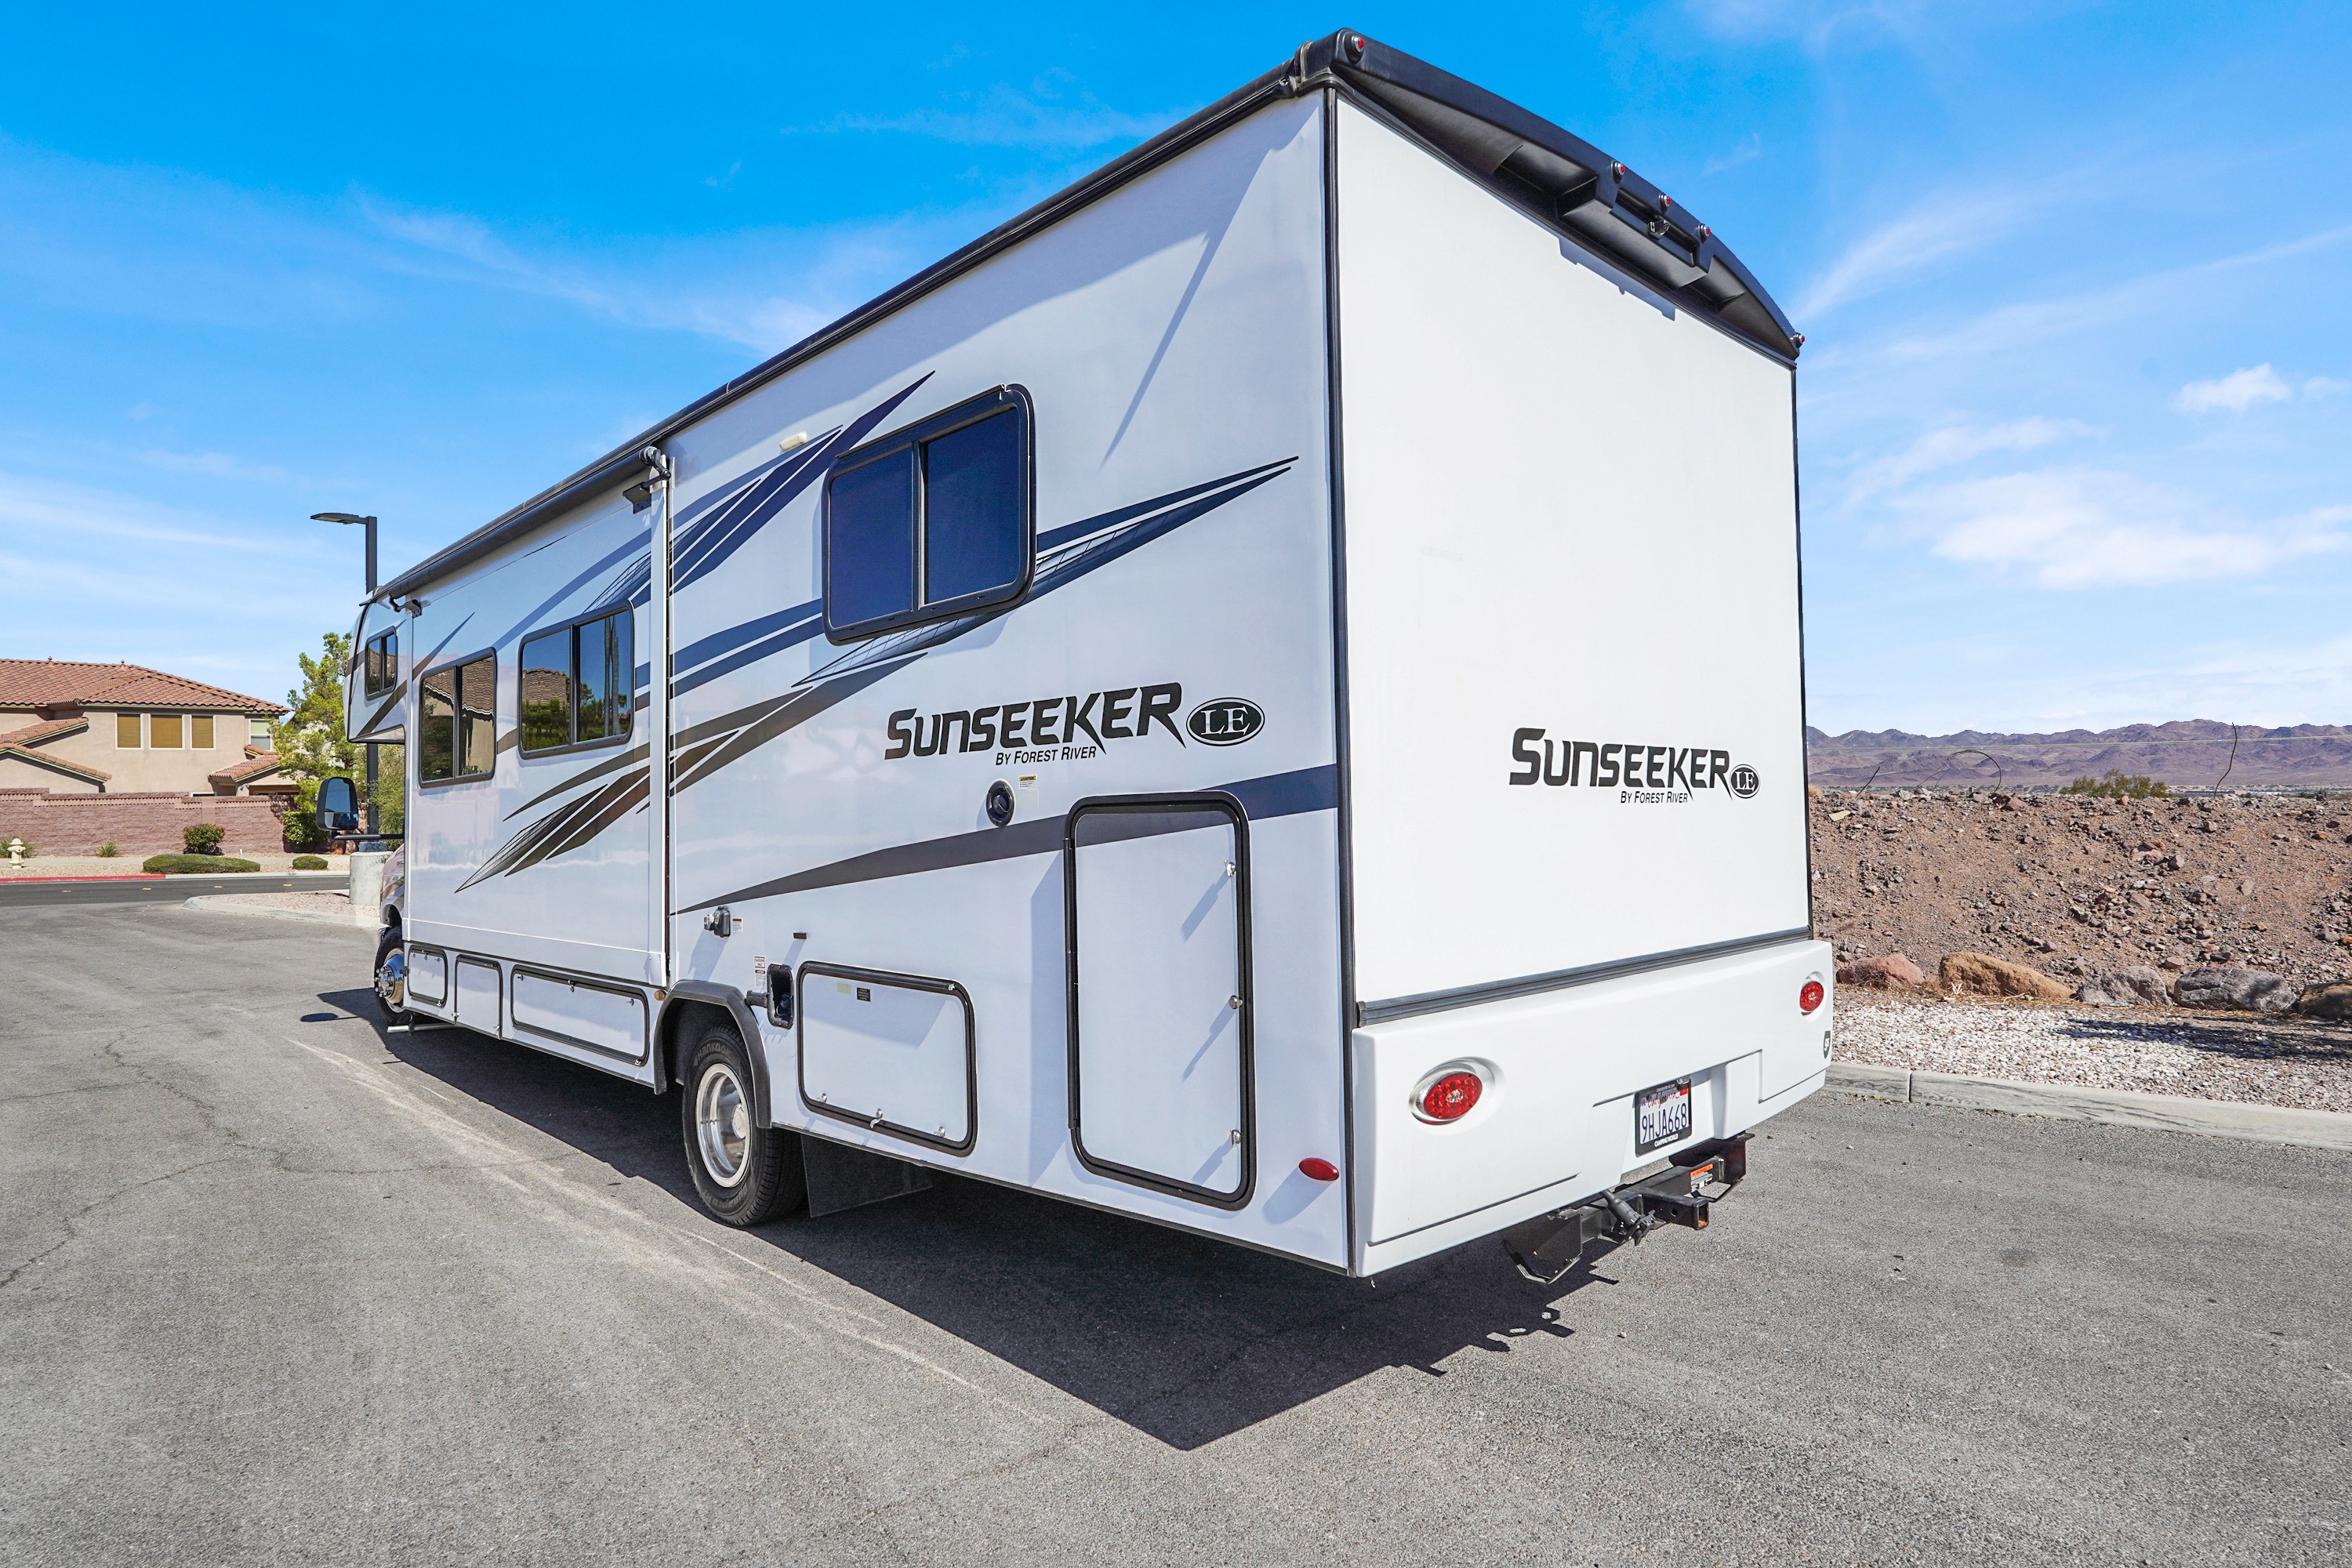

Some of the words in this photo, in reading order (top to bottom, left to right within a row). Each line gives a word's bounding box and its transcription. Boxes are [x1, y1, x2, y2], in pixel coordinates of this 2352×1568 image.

[1200, 706, 1250, 735] LE
[1734, 771, 1755, 792] LE
[1642, 1103, 1686, 1142] 9HJA668
